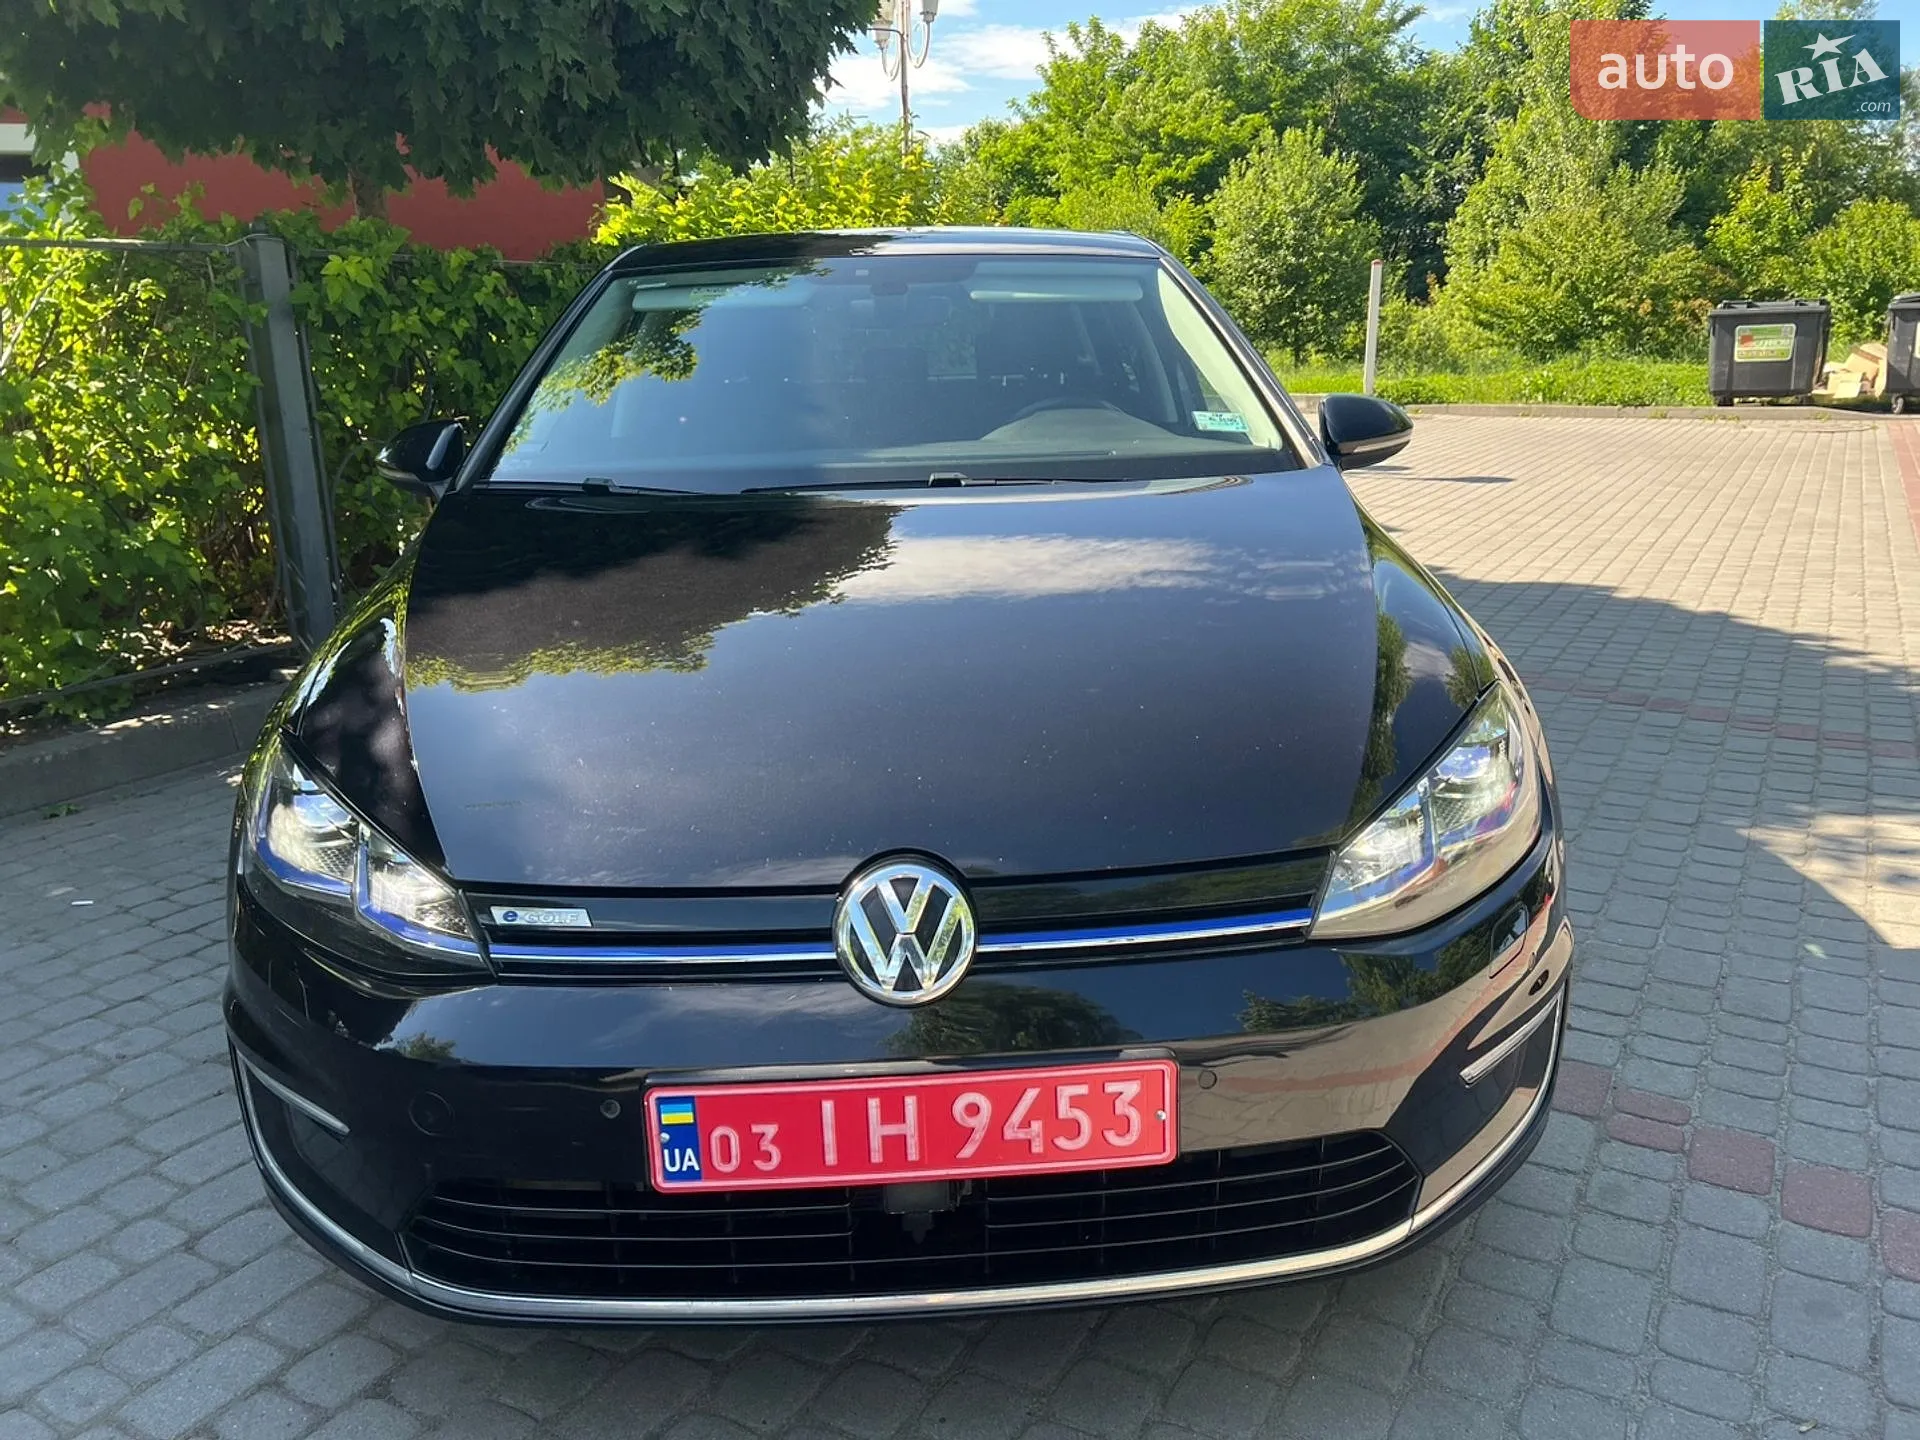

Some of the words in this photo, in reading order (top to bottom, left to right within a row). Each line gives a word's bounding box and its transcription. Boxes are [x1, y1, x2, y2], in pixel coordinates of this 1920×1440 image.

[709, 1123, 782, 1173] 03
[821, 1095, 919, 1166] IH
[952, 1080, 1142, 1159] 9453
[663, 1147, 700, 1172] UA
